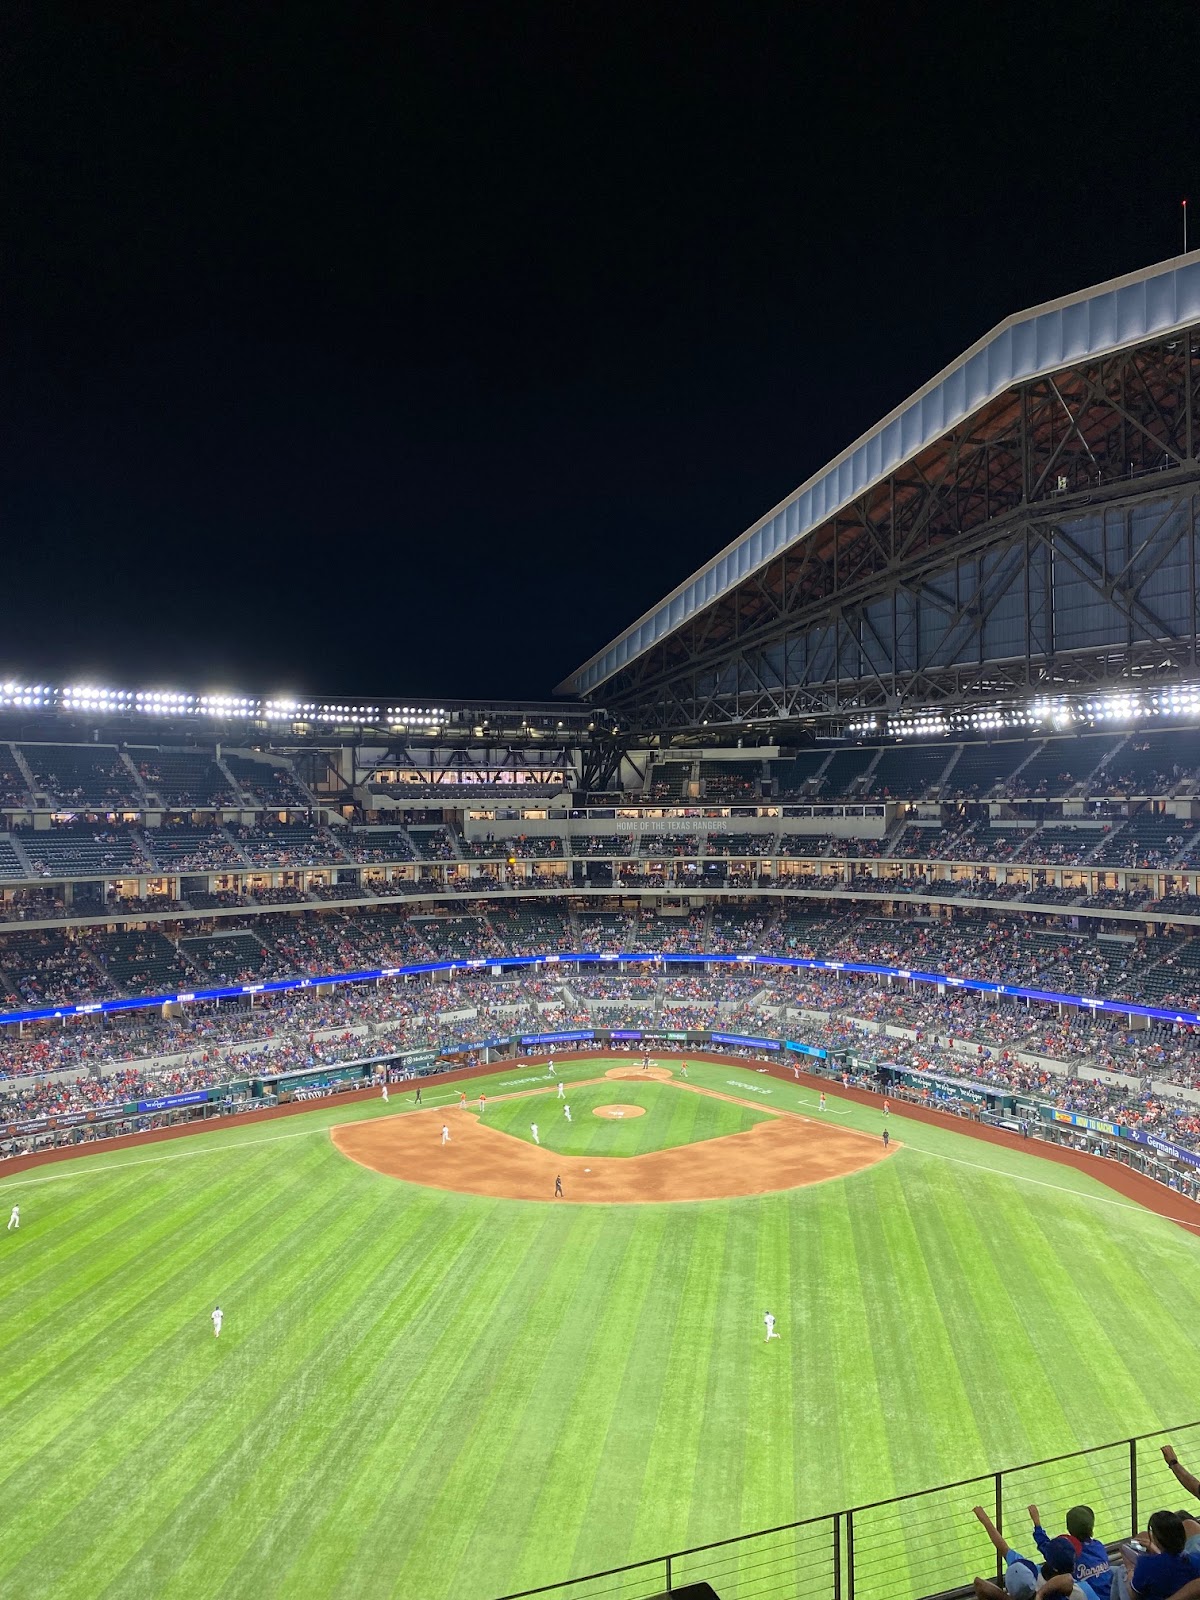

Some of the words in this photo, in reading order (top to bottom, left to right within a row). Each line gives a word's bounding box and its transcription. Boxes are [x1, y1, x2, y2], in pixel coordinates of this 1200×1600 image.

[616, 821, 638, 830] HOME
[640, 821, 649, 830] OF
[651, 821, 665, 830] THE
[668, 821, 690, 830] TEXAS
[692, 821, 727, 830] RANGERS
[1147, 1136, 1180, 1158] Germania
[1076, 1561, 1110, 1580] Rangers
